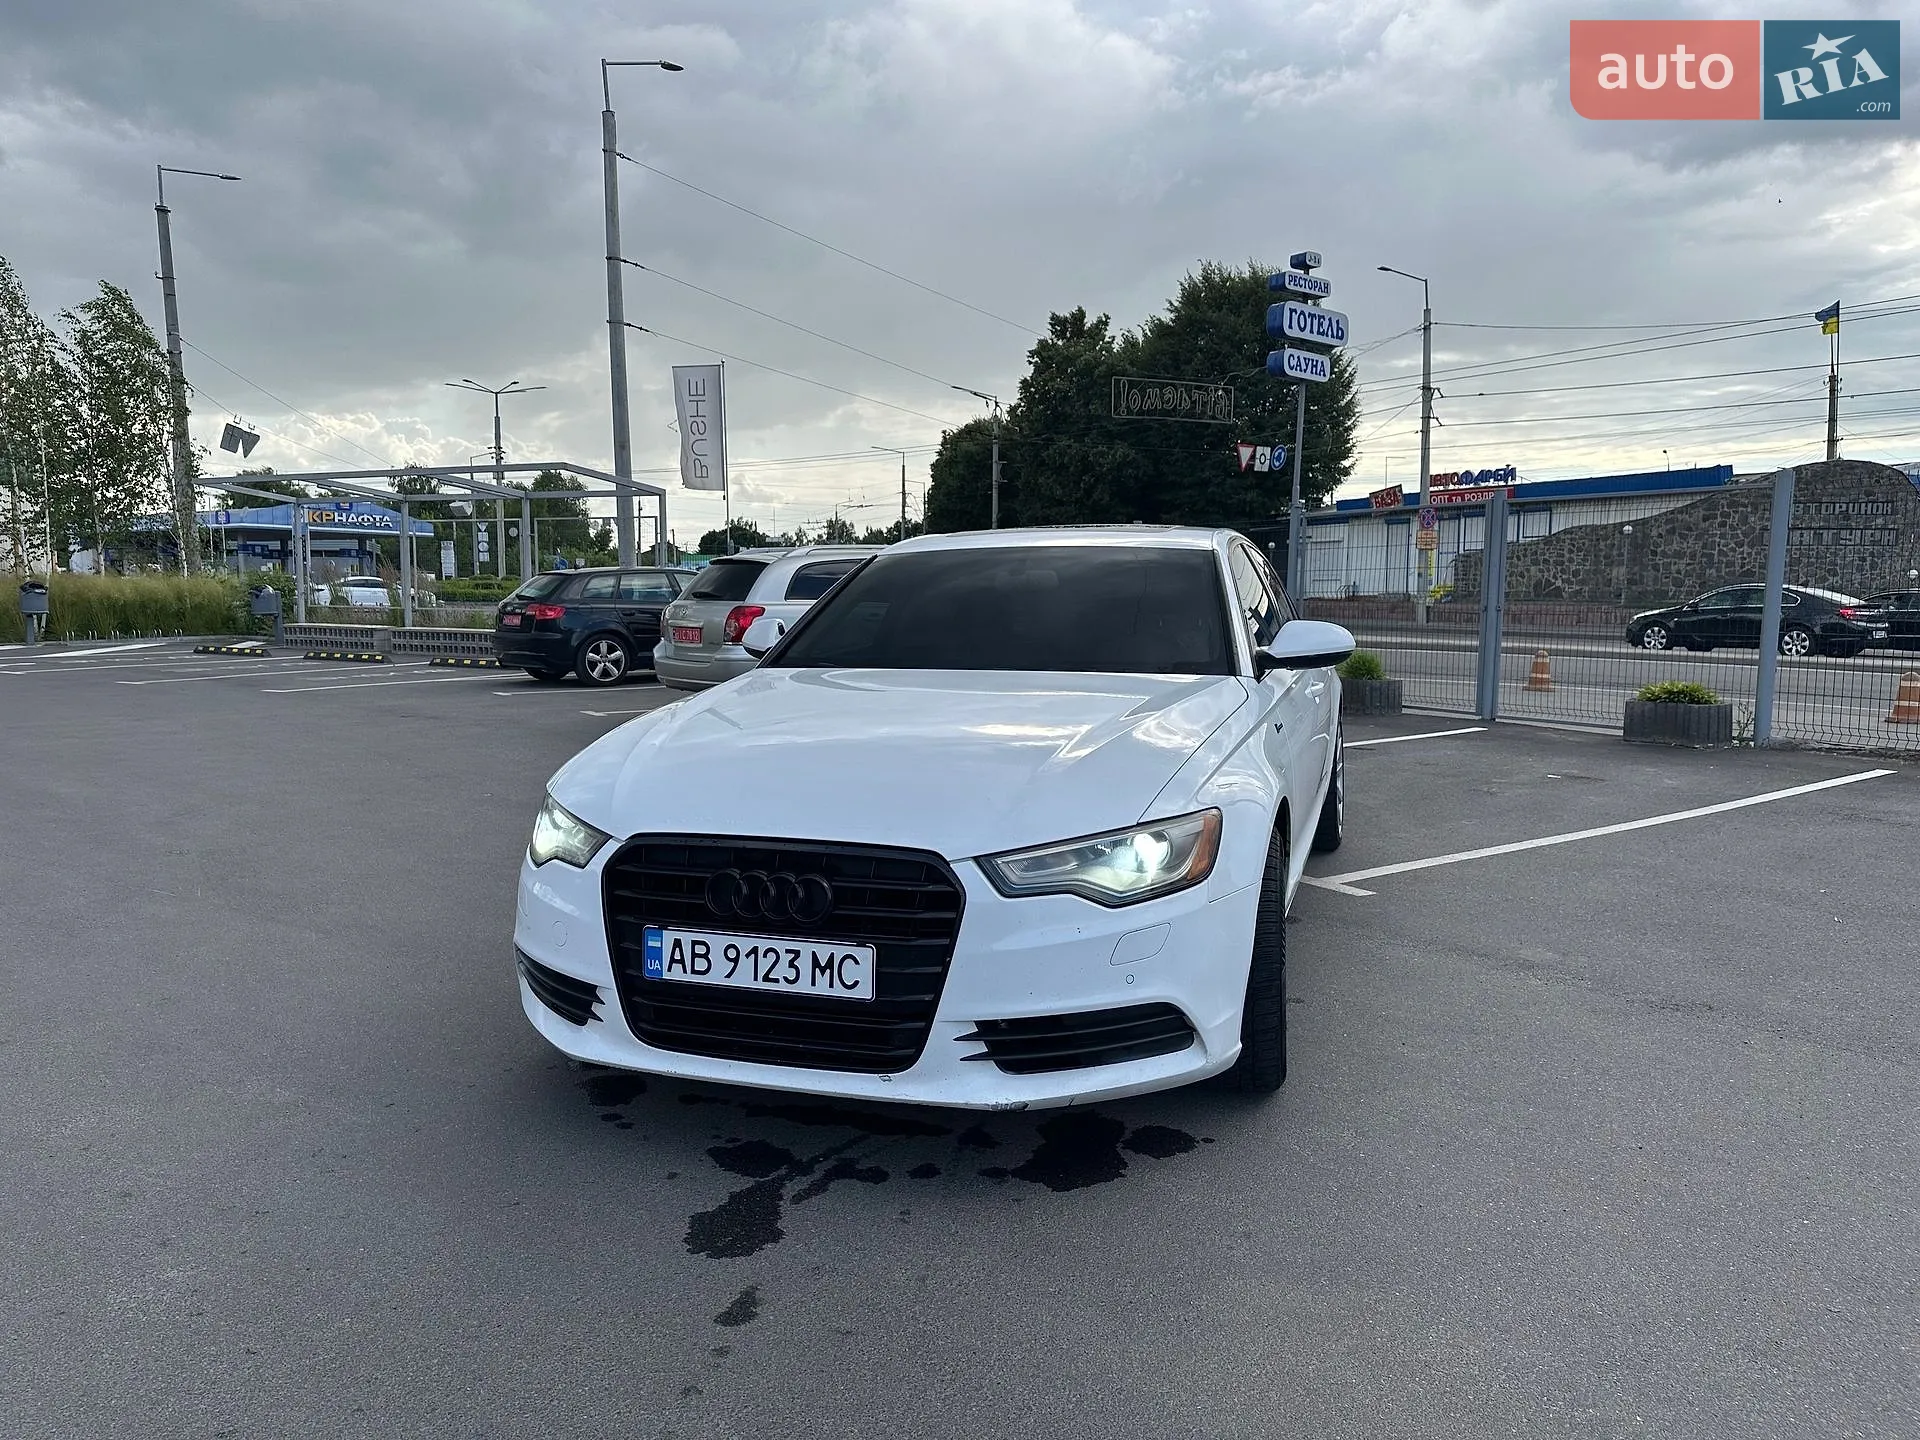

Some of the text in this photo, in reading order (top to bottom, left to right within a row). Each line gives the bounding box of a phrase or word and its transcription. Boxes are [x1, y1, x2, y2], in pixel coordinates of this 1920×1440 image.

[1288, 274, 1329, 294] РЕСТОРАН
[1288, 307, 1345, 340] ГОТЕЛЬ
[1287, 354, 1327, 377] САУНА
[1429, 467, 1517, 487] ВТОФАРБИ
[1431, 495, 1449, 504] ОПТ
[1465, 491, 1496, 502] РОЗДР
[303, 510, 393, 528] КРНАФТА
[1793, 502, 1892, 516] ВТОРИНОК
[647, 959, 661, 971] UA
[667, 938, 861, 990] AB 9123 MC
